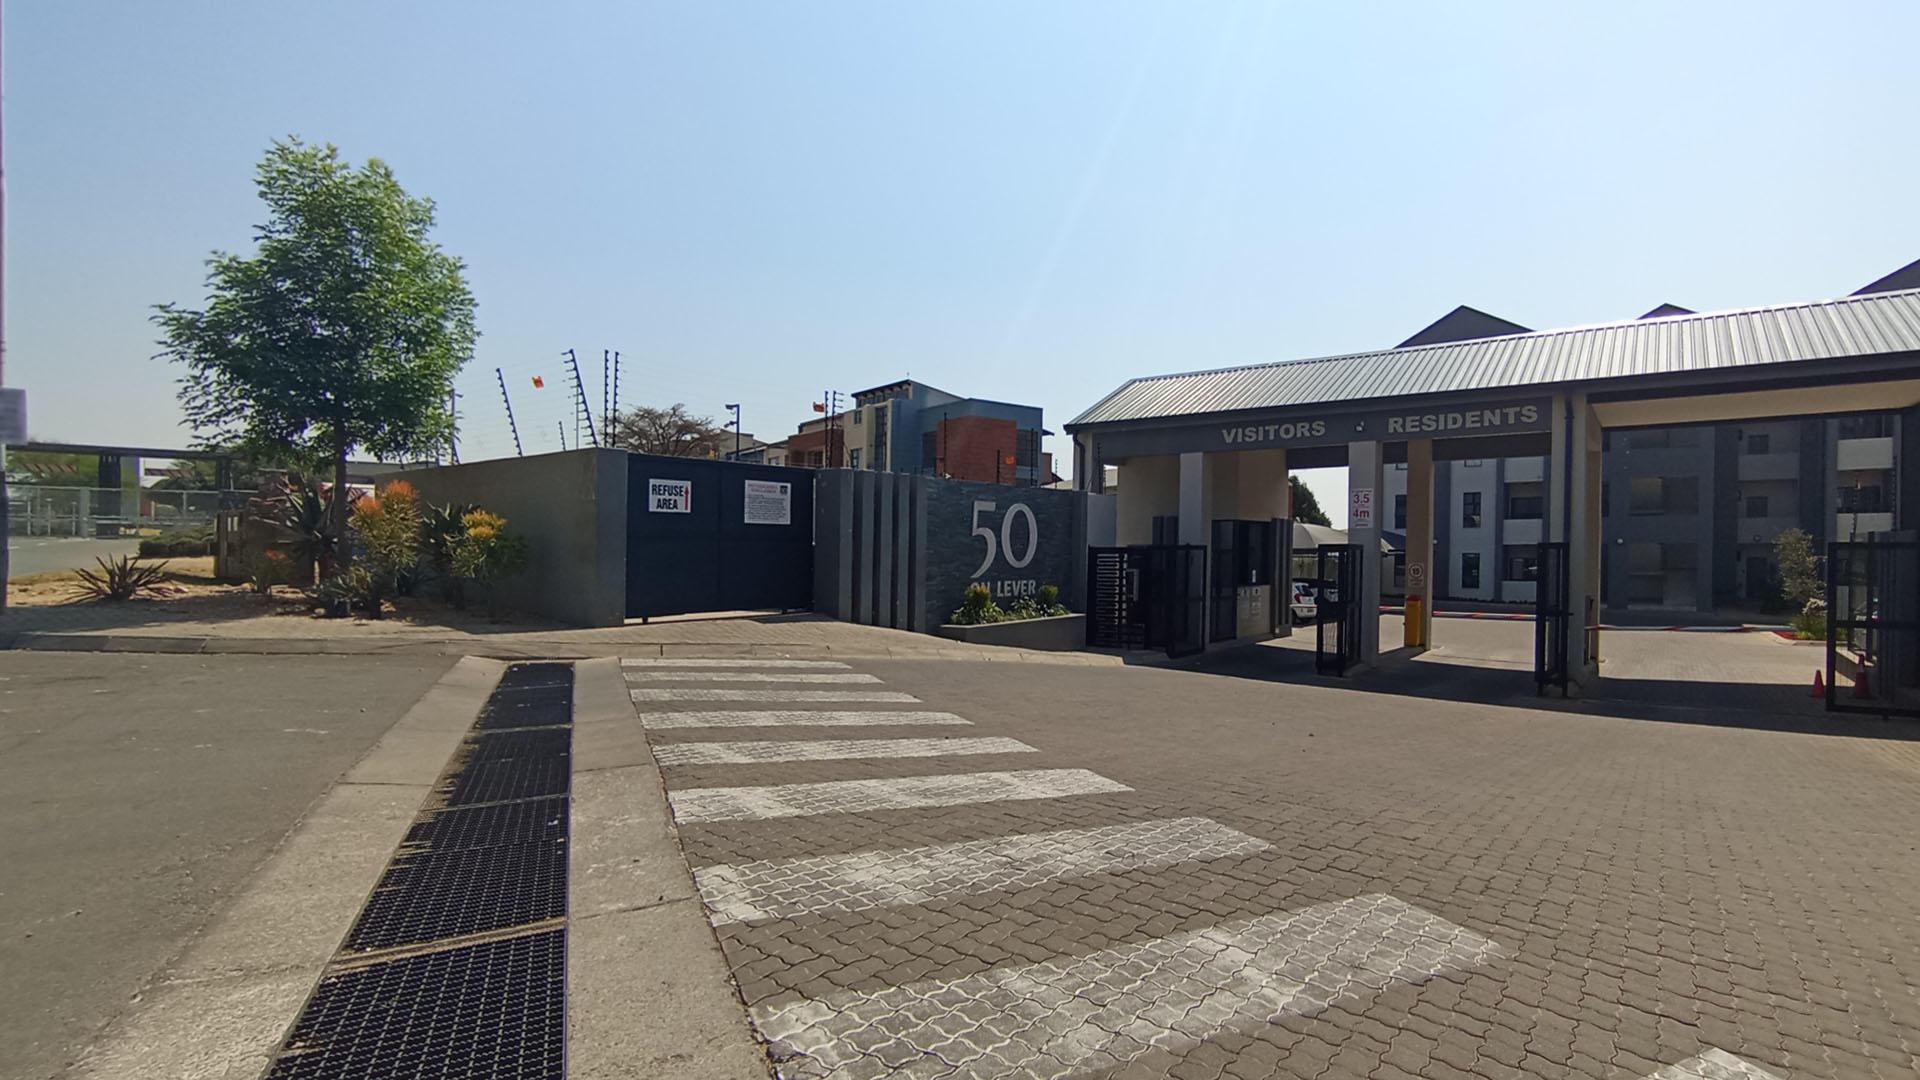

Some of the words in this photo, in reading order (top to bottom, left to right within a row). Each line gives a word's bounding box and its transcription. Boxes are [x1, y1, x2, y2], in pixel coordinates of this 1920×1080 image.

[1388, 405, 1538, 433] RESIDENTS
[1222, 421, 1326, 444] VISITORS
[651, 484, 684, 497] REFUSE
[656, 498, 678, 510] AREA
[970, 500, 1038, 579] 50
[997, 580, 1036, 597] LEVER
